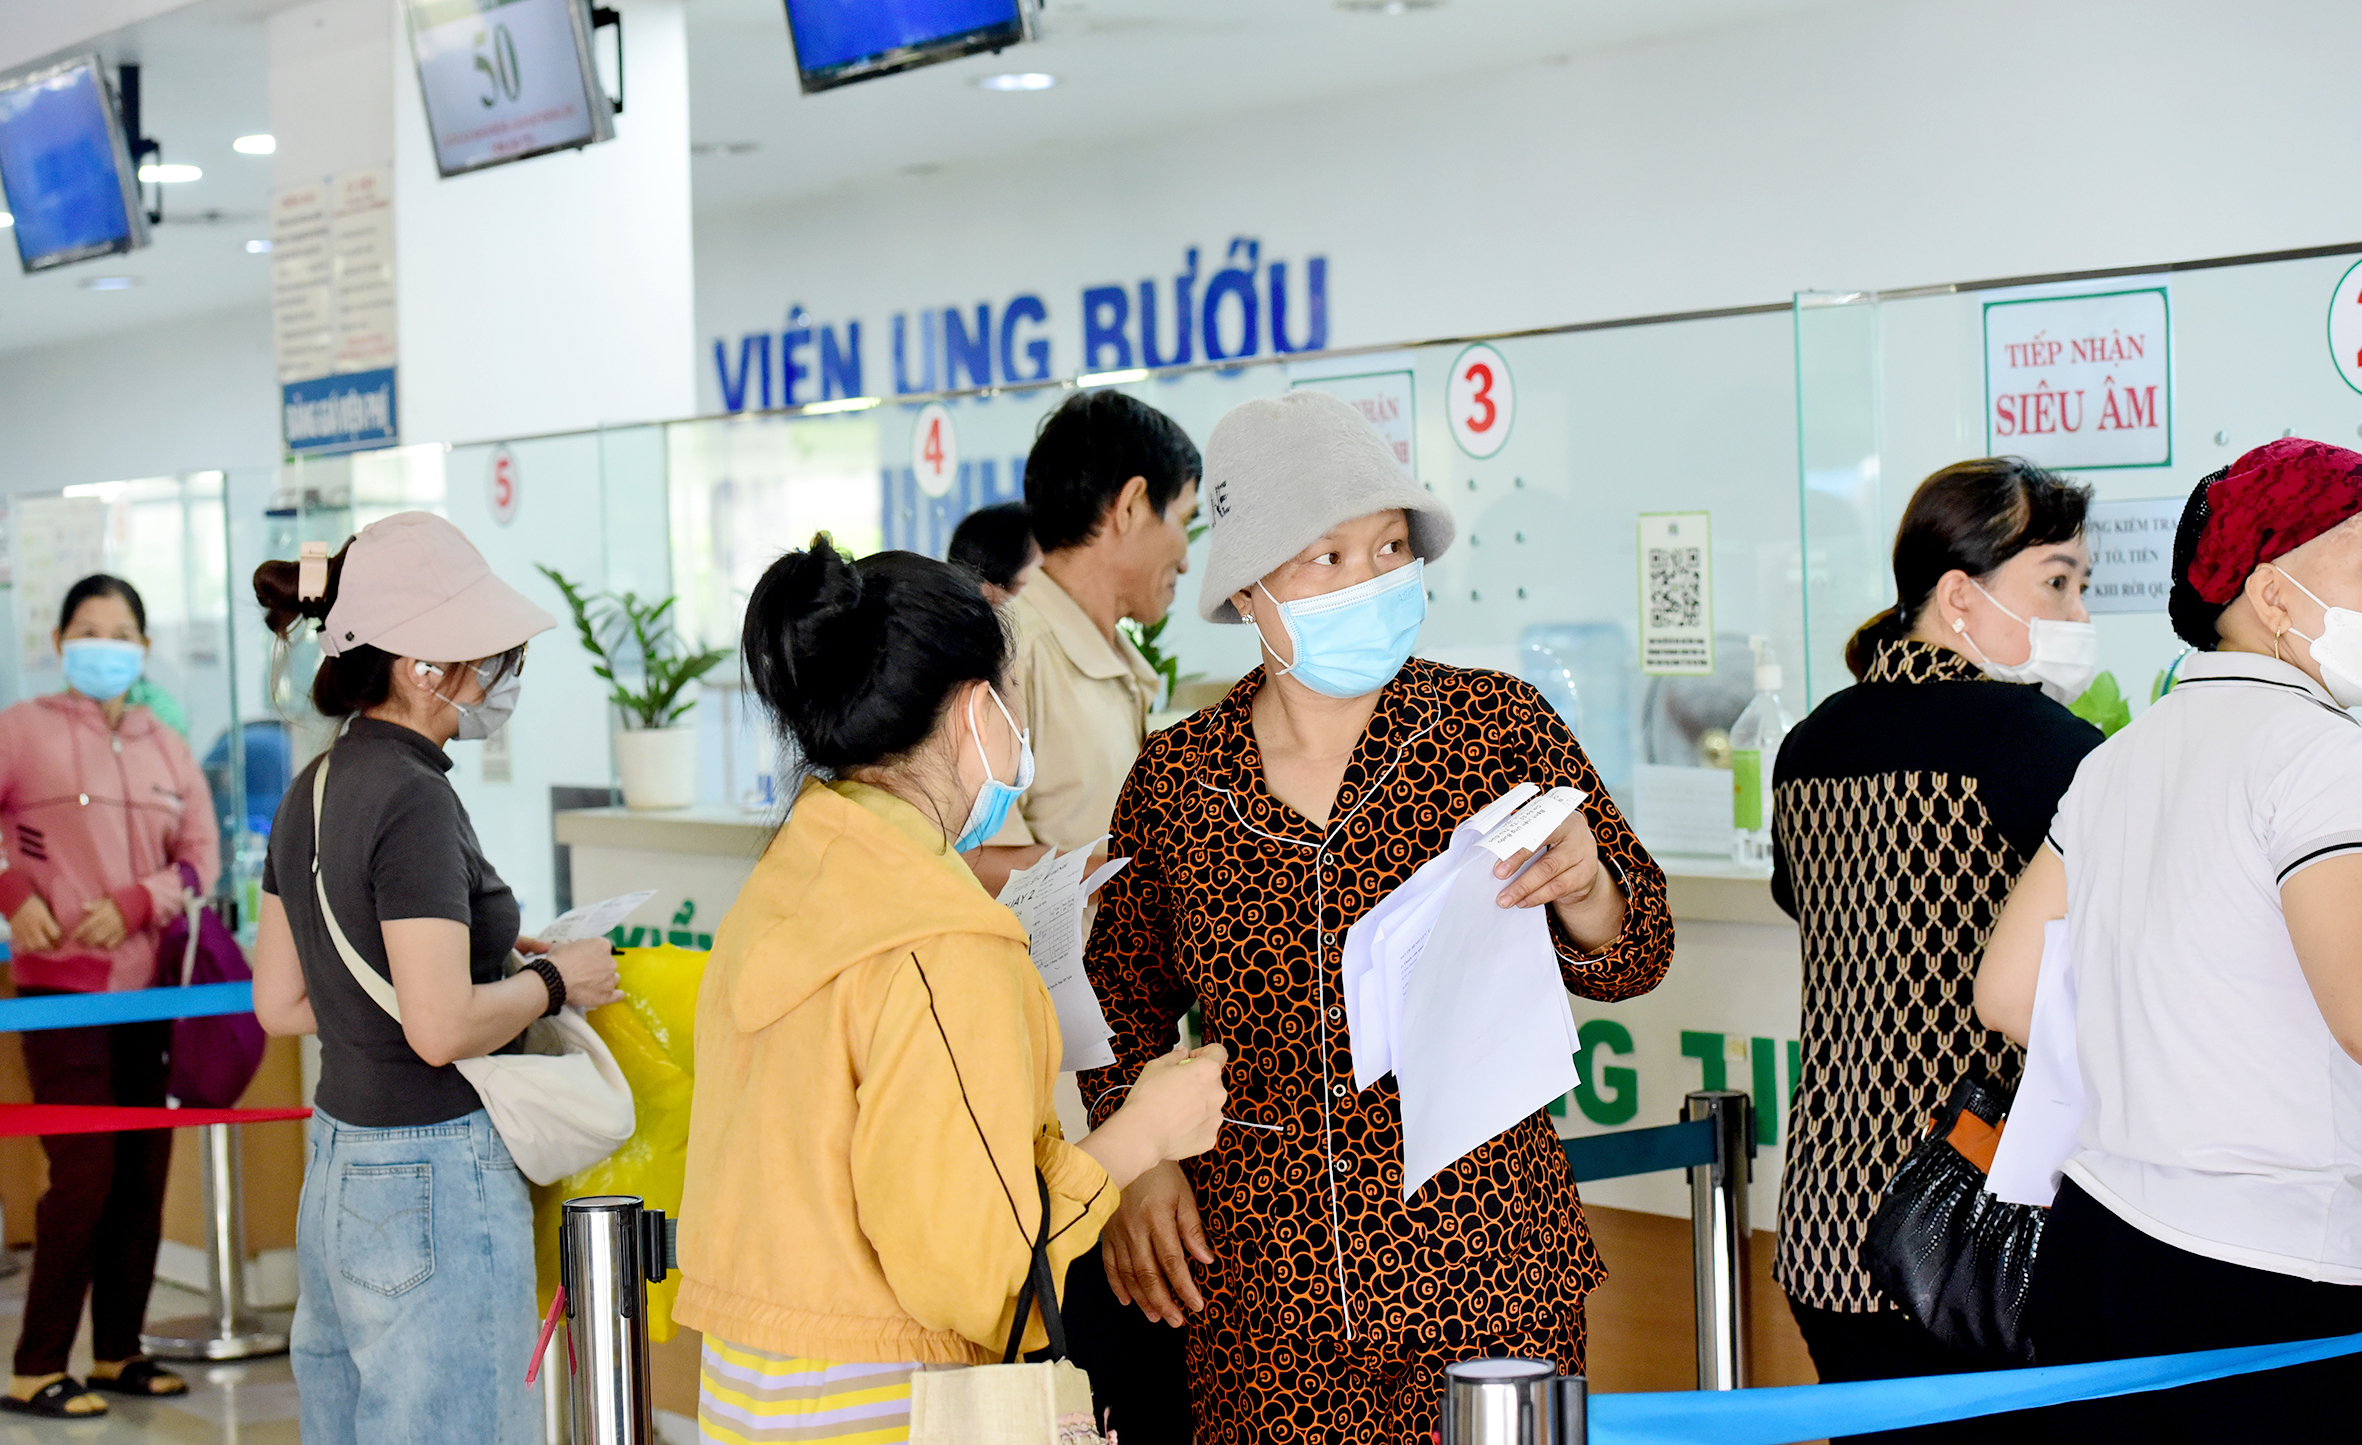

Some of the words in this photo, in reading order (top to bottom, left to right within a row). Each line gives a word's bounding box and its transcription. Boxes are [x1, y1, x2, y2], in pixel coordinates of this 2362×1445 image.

[474, 20, 521, 109] 50
[2004, 328, 2063, 369] TIẾP
[2071, 327, 2146, 368] NHẬN
[1464, 362, 1498, 434] 3
[1995, 378, 2085, 437] SIÊU
[2096, 373, 2160, 431] ÂM
[924, 417, 944, 475] 4
[494, 457, 512, 507] 5
